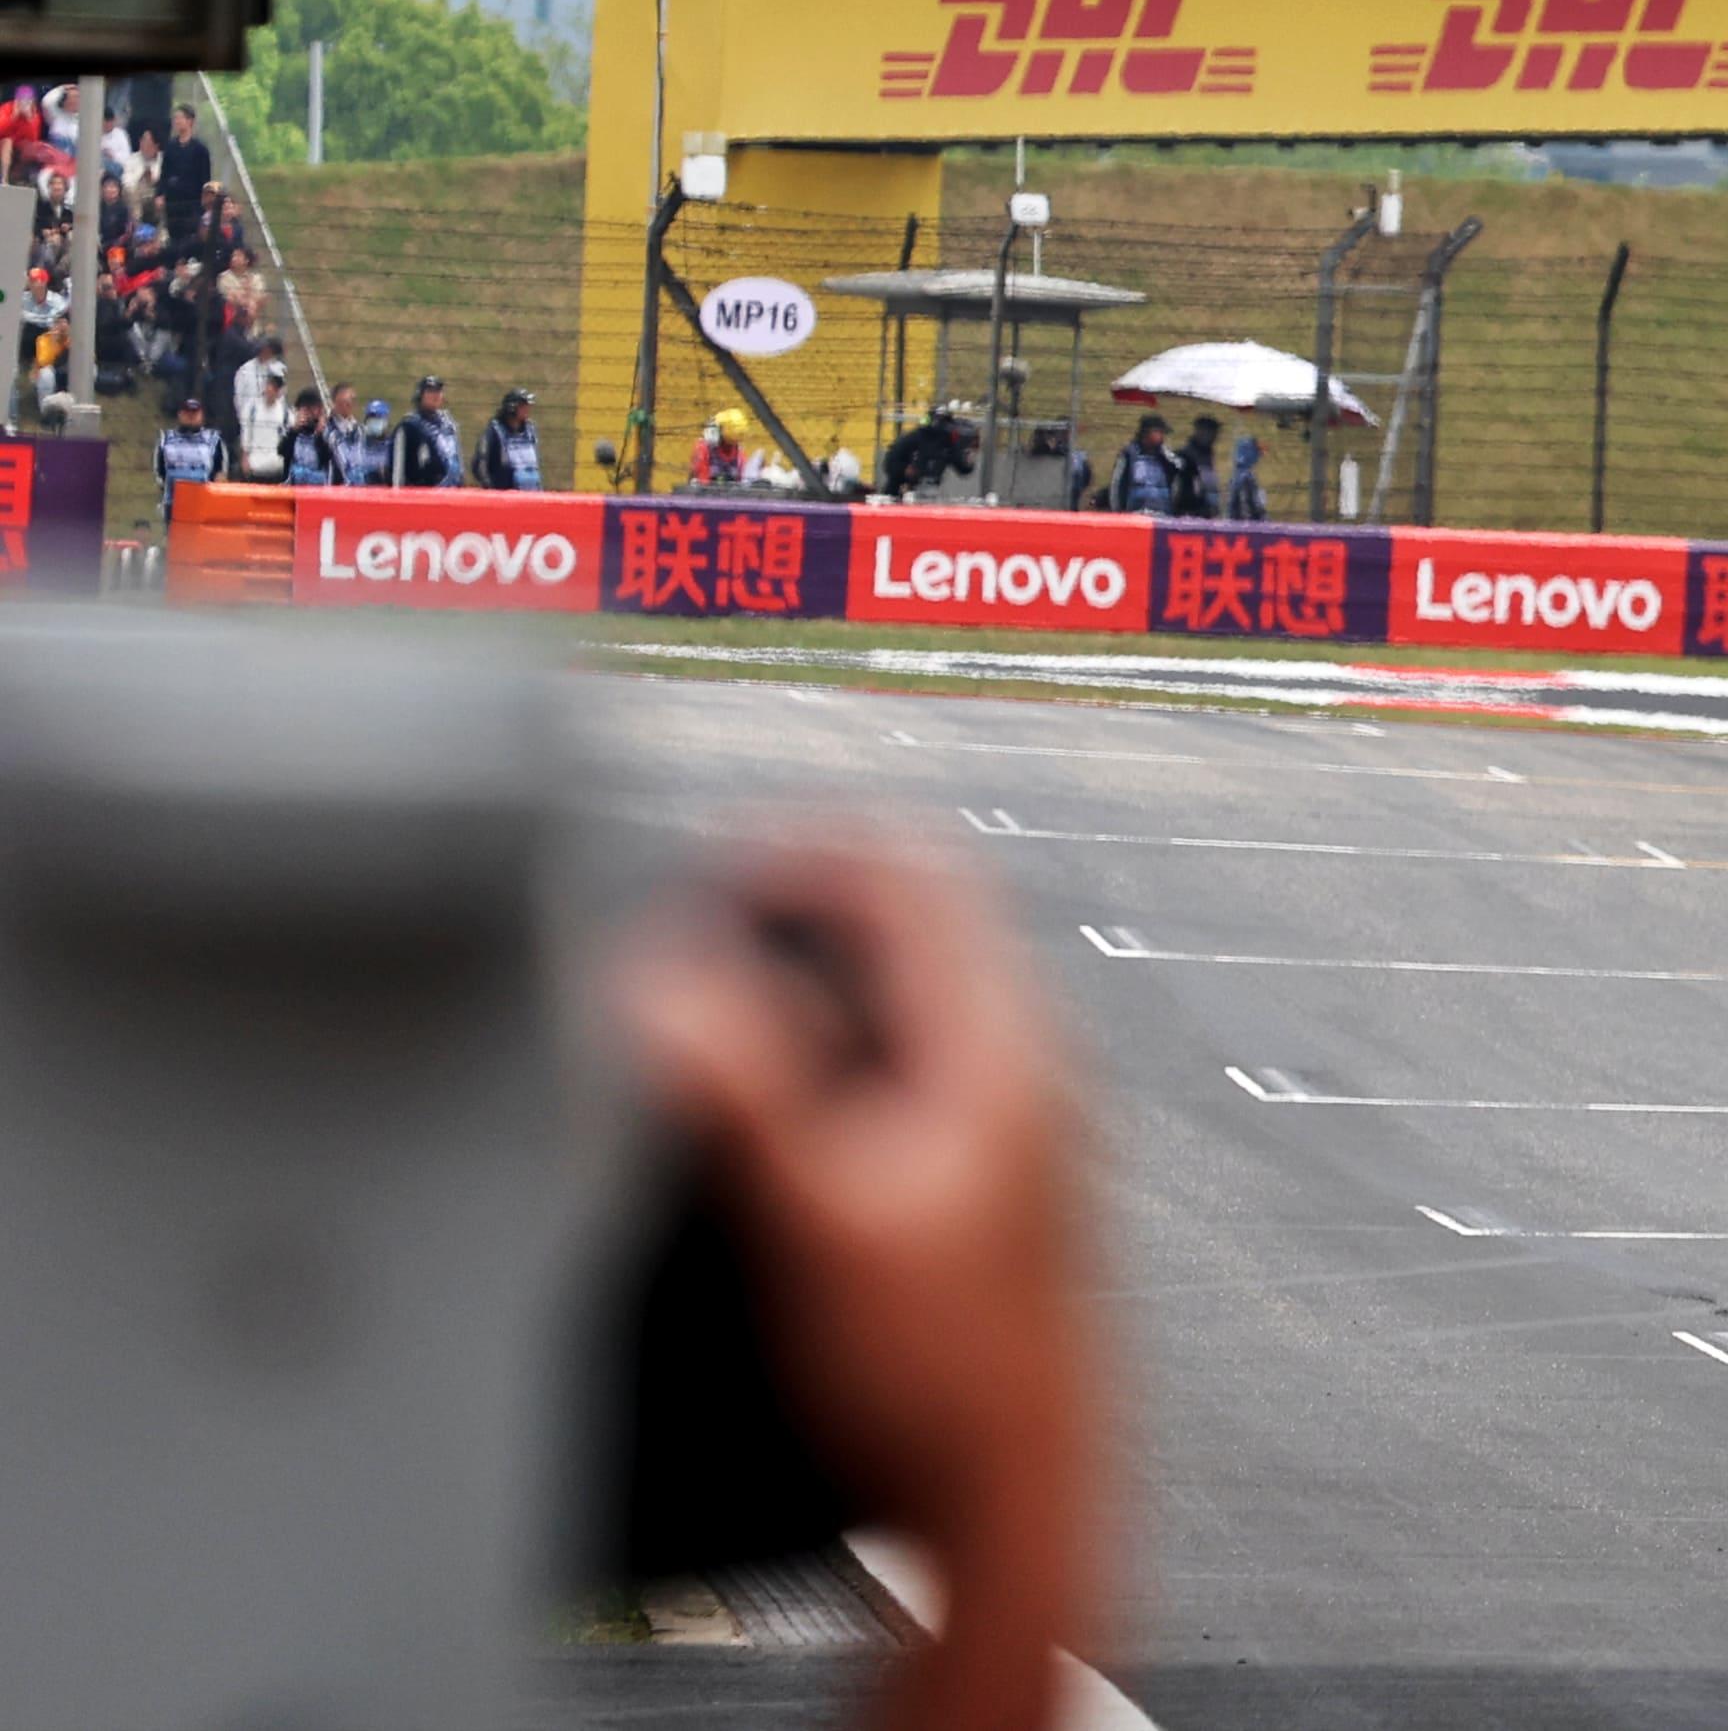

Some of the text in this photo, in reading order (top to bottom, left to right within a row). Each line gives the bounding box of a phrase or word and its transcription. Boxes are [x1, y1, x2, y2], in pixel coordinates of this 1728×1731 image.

[716, 299, 798, 332] MP16
[318, 516, 577, 585] Lenovo
[616, 510, 806, 611] 联想
[873, 535, 1126, 608] Lenovo
[1164, 533, 1348, 636] 联想
[1416, 557, 1662, 631] Lenovo
